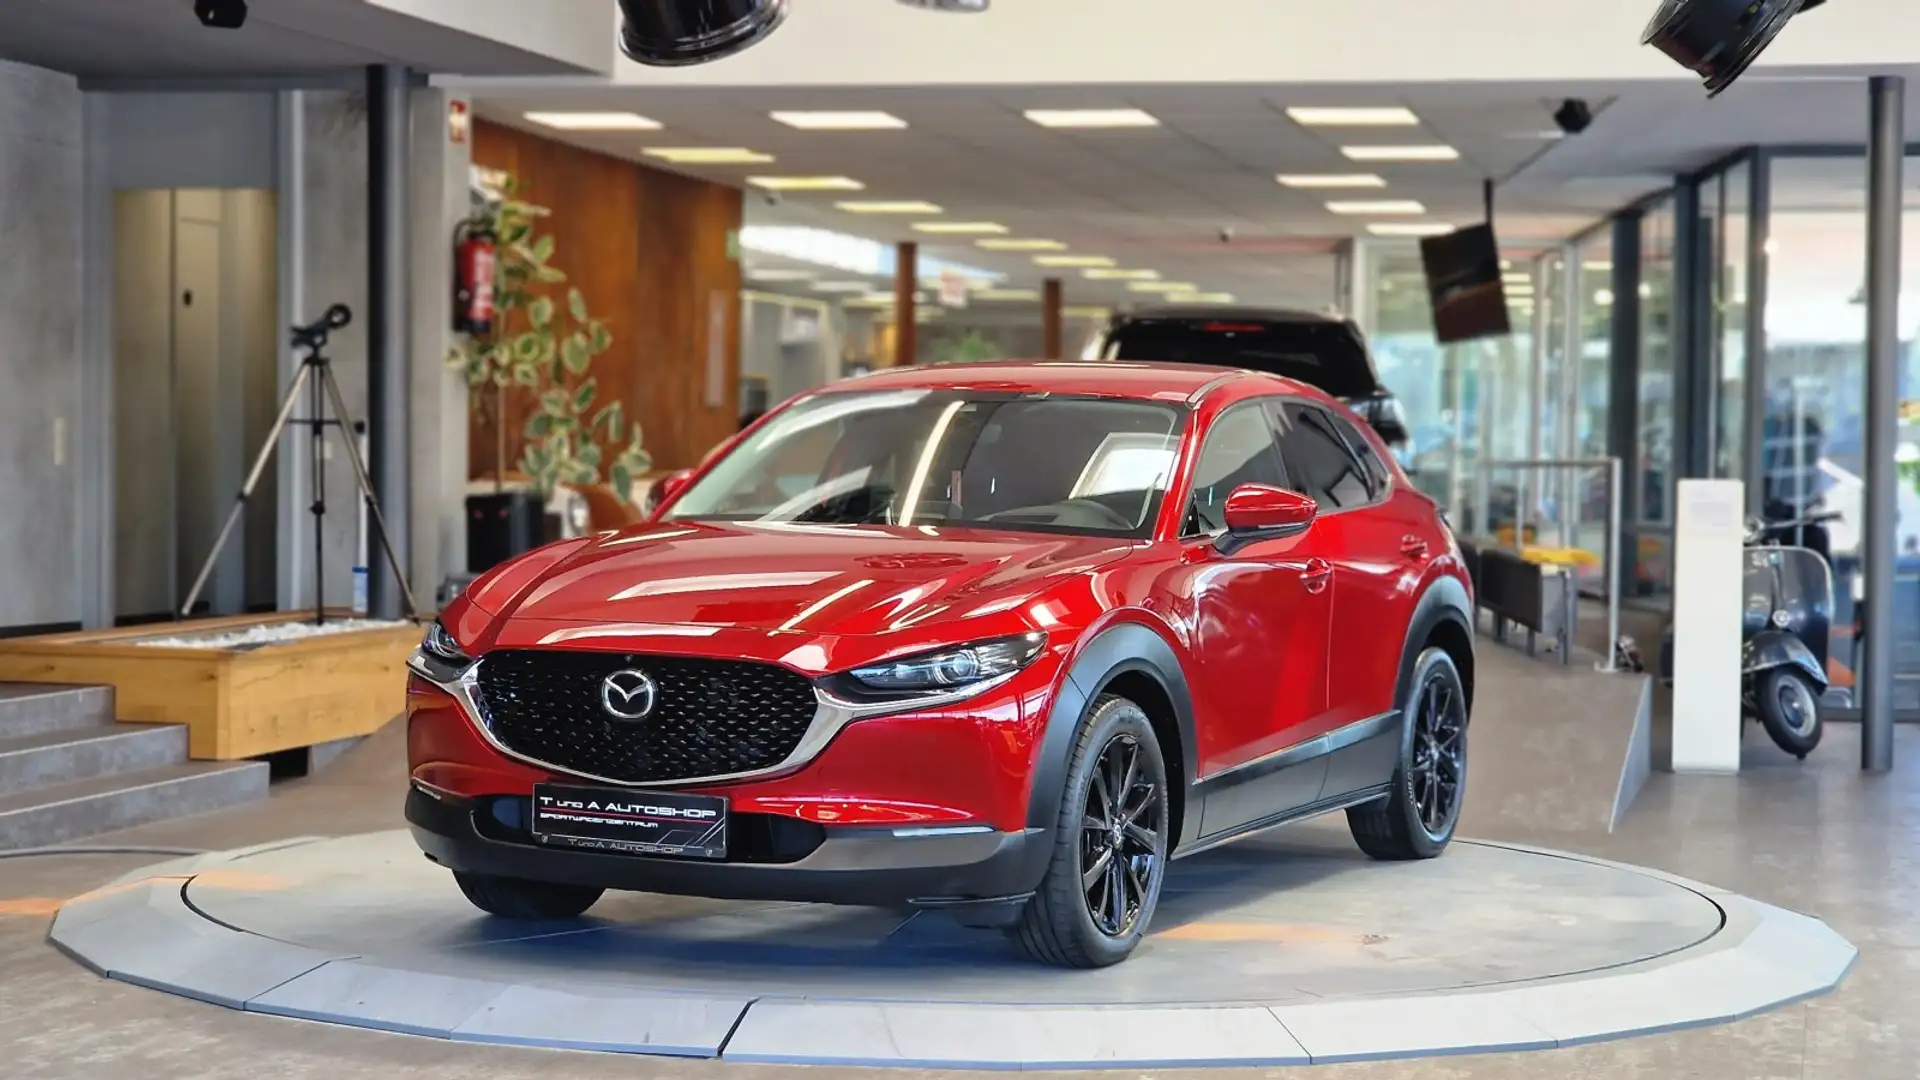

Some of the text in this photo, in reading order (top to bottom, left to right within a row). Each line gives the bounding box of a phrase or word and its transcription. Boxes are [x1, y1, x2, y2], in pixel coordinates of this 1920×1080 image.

[539, 796, 553, 806] T
[587, 801, 601, 810] A
[605, 802, 716, 819] AUTOSHOP
[567, 837, 577, 846] T
[596, 841, 605, 849] A
[609, 842, 684, 854] AUTOSHOP
